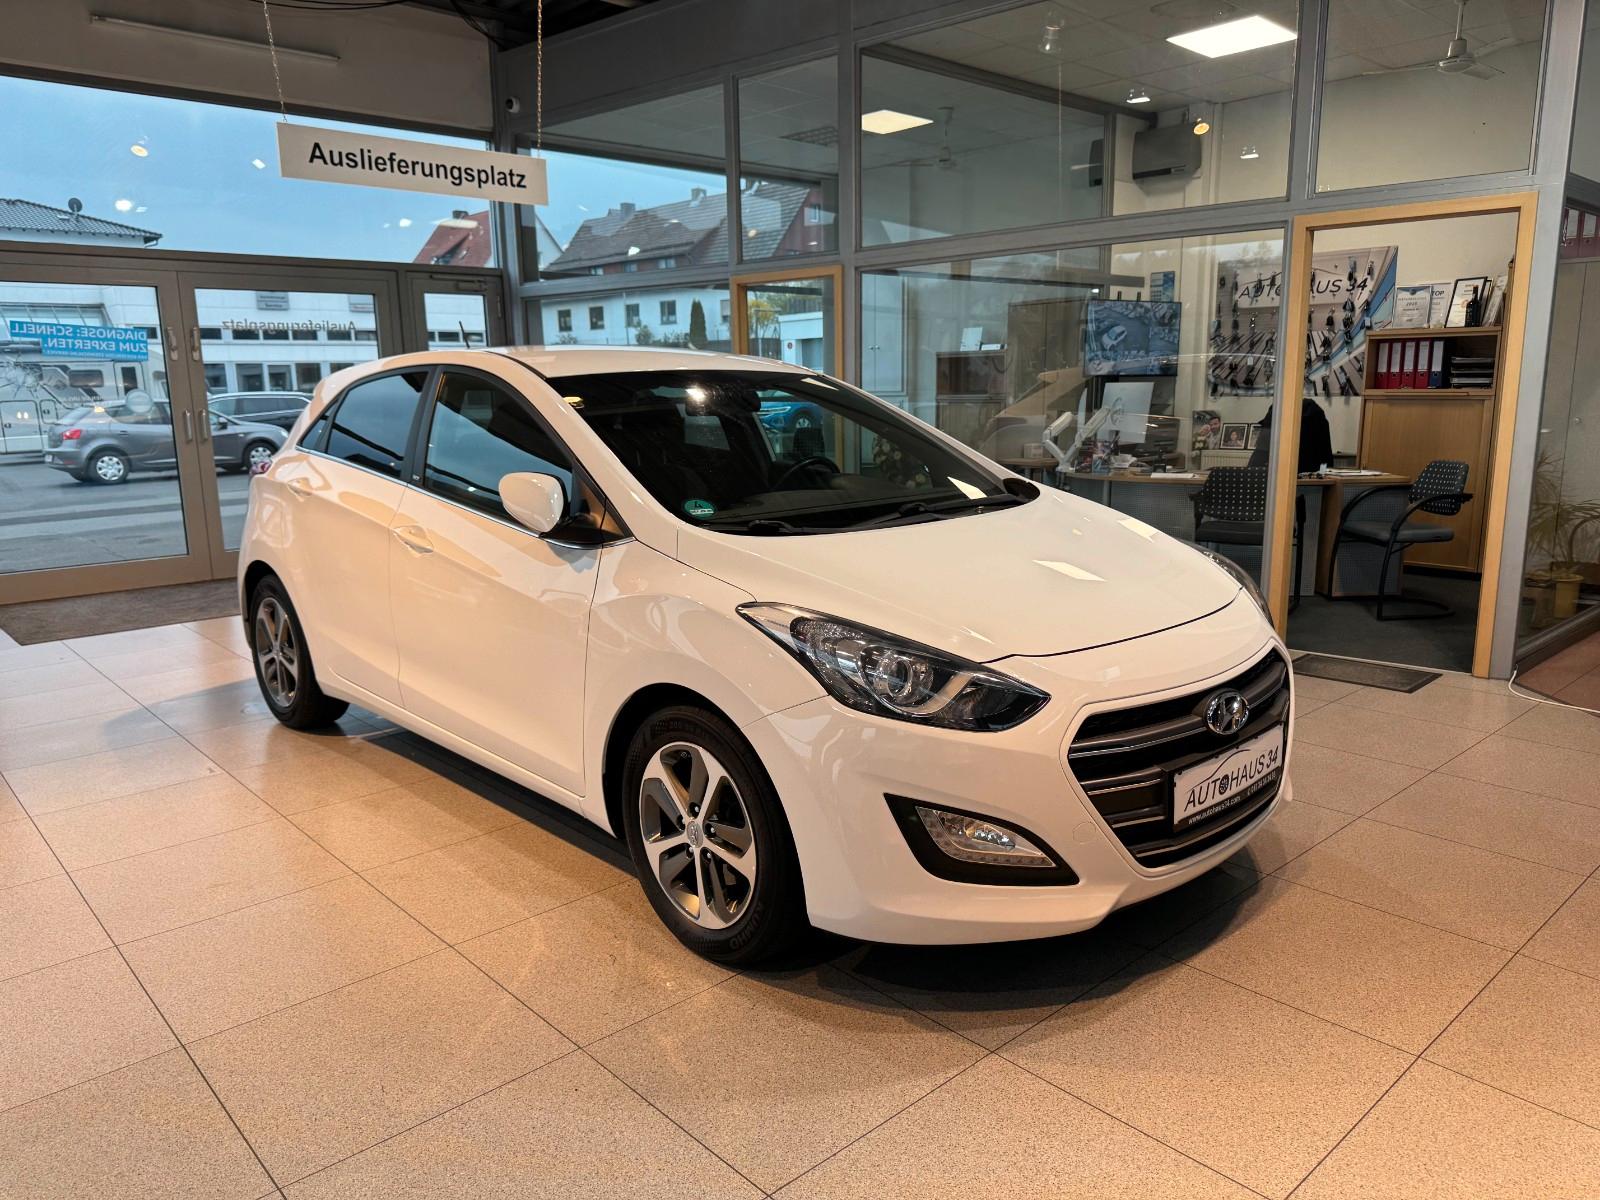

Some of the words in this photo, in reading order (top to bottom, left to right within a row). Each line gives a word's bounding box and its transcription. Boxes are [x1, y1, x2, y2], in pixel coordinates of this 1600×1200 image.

[308, 141, 528, 190] Auslieferungsplatz
[1184, 754, 1265, 812] AUTOHAUS
[1266, 745, 1279, 769] 34
